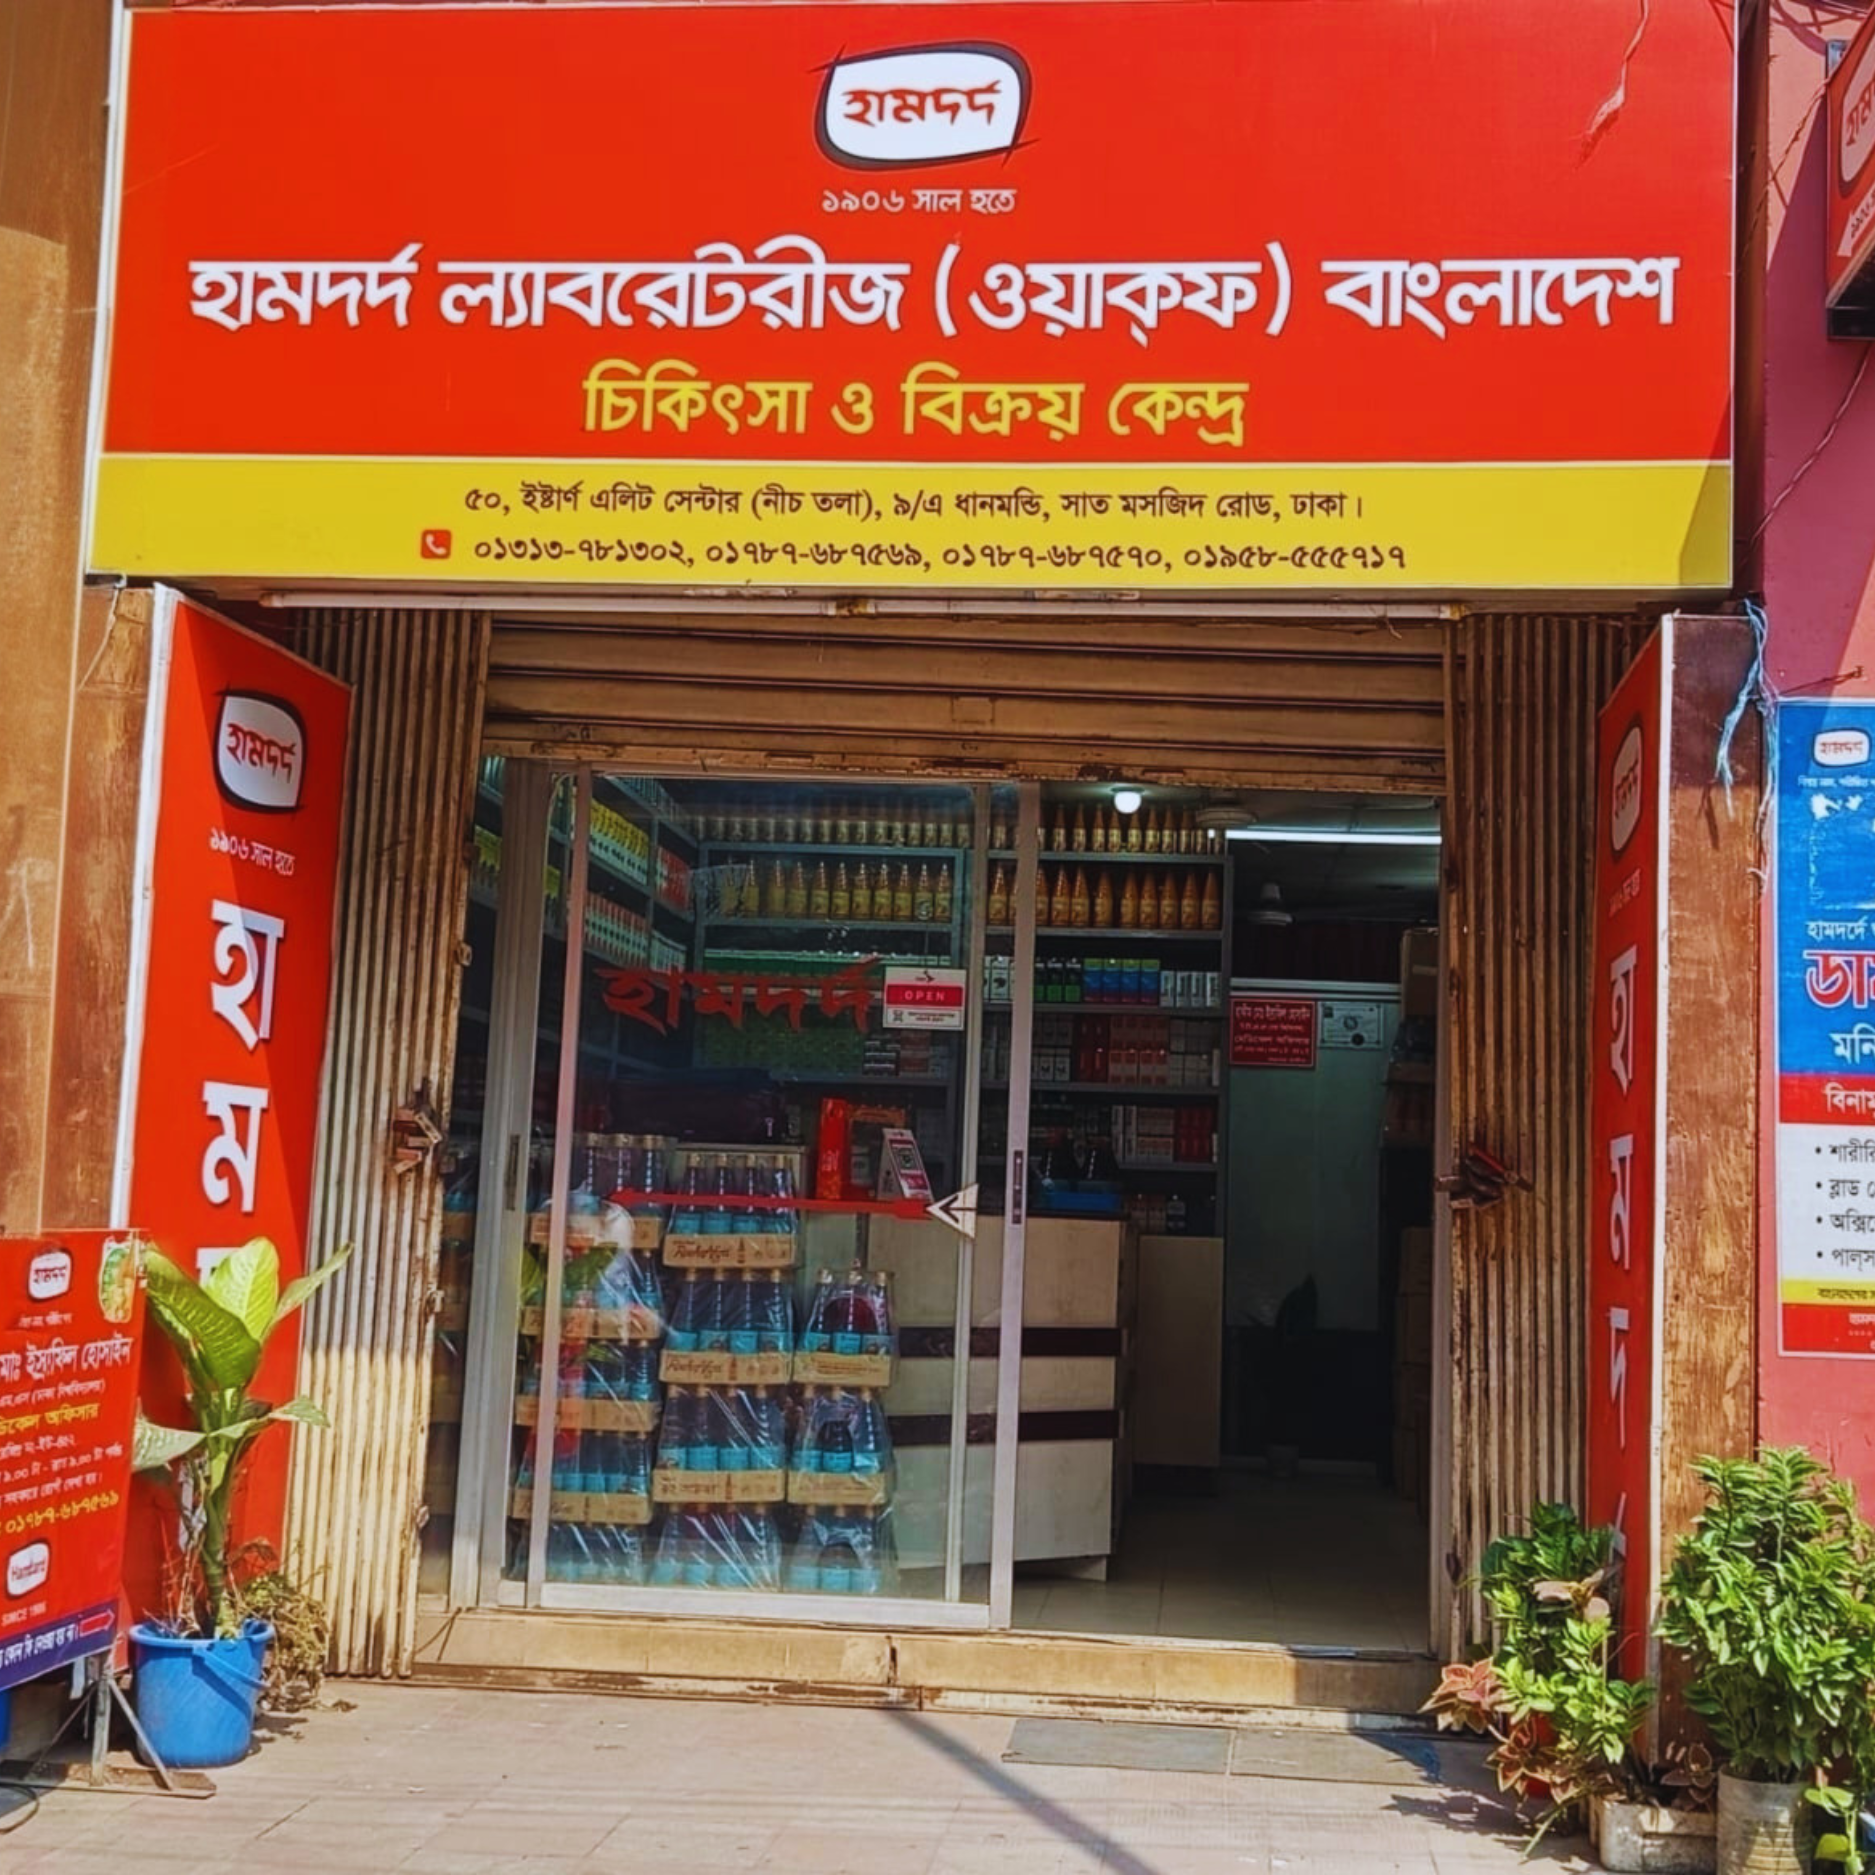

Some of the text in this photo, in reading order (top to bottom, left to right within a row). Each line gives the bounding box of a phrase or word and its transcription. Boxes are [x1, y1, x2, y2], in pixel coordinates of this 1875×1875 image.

[842, 80, 1000, 126] হামদর্দ
[823, 189, 1017, 213] ১৯০৬ সাল হতে
[189, 243, 423, 330] হামদর্দ
[438, 234, 911, 331] ল্যাবরেটরীজ
[1321, 257, 1680, 338] বাংলাদেশ
[582, 358, 1250, 447] চিকিৎসা ও বিক্রয় কেন্দ্র
[465, 488, 510, 515] ৫০,
[590, 481, 655, 512] এলিট
[664, 484, 741, 514] সেন্টার
[751, 483, 803, 520] (নীচ
[811, 490, 883, 521] তলা),
[893, 489, 943, 517] ৯/এ
[1060, 492, 1112, 518] সাত
[1118, 486, 1207, 518] মসজিদ
[1216, 492, 1281, 522] রোড,
[475, 537, 1405, 572] ০১৩১৩-৭৮১৩০২, ০১৭৮৭-৬৮৭৫৬৯, ০১৭৮৭-৬৮৭৫৭০, ০১৯৫৮-৫৫৫৭১৭
[226, 722, 297, 786] হামদর্দ
[1806, 916, 1868, 943] হামদর্দে
[594, 953, 883, 1038] হামদর্দ
[904, 989, 946, 1001] OPEN
[1803, 949, 1875, 1010] ডা
[1829, 1021, 1875, 1066] মনি
[44, 1403, 101, 1427] অফিসার
